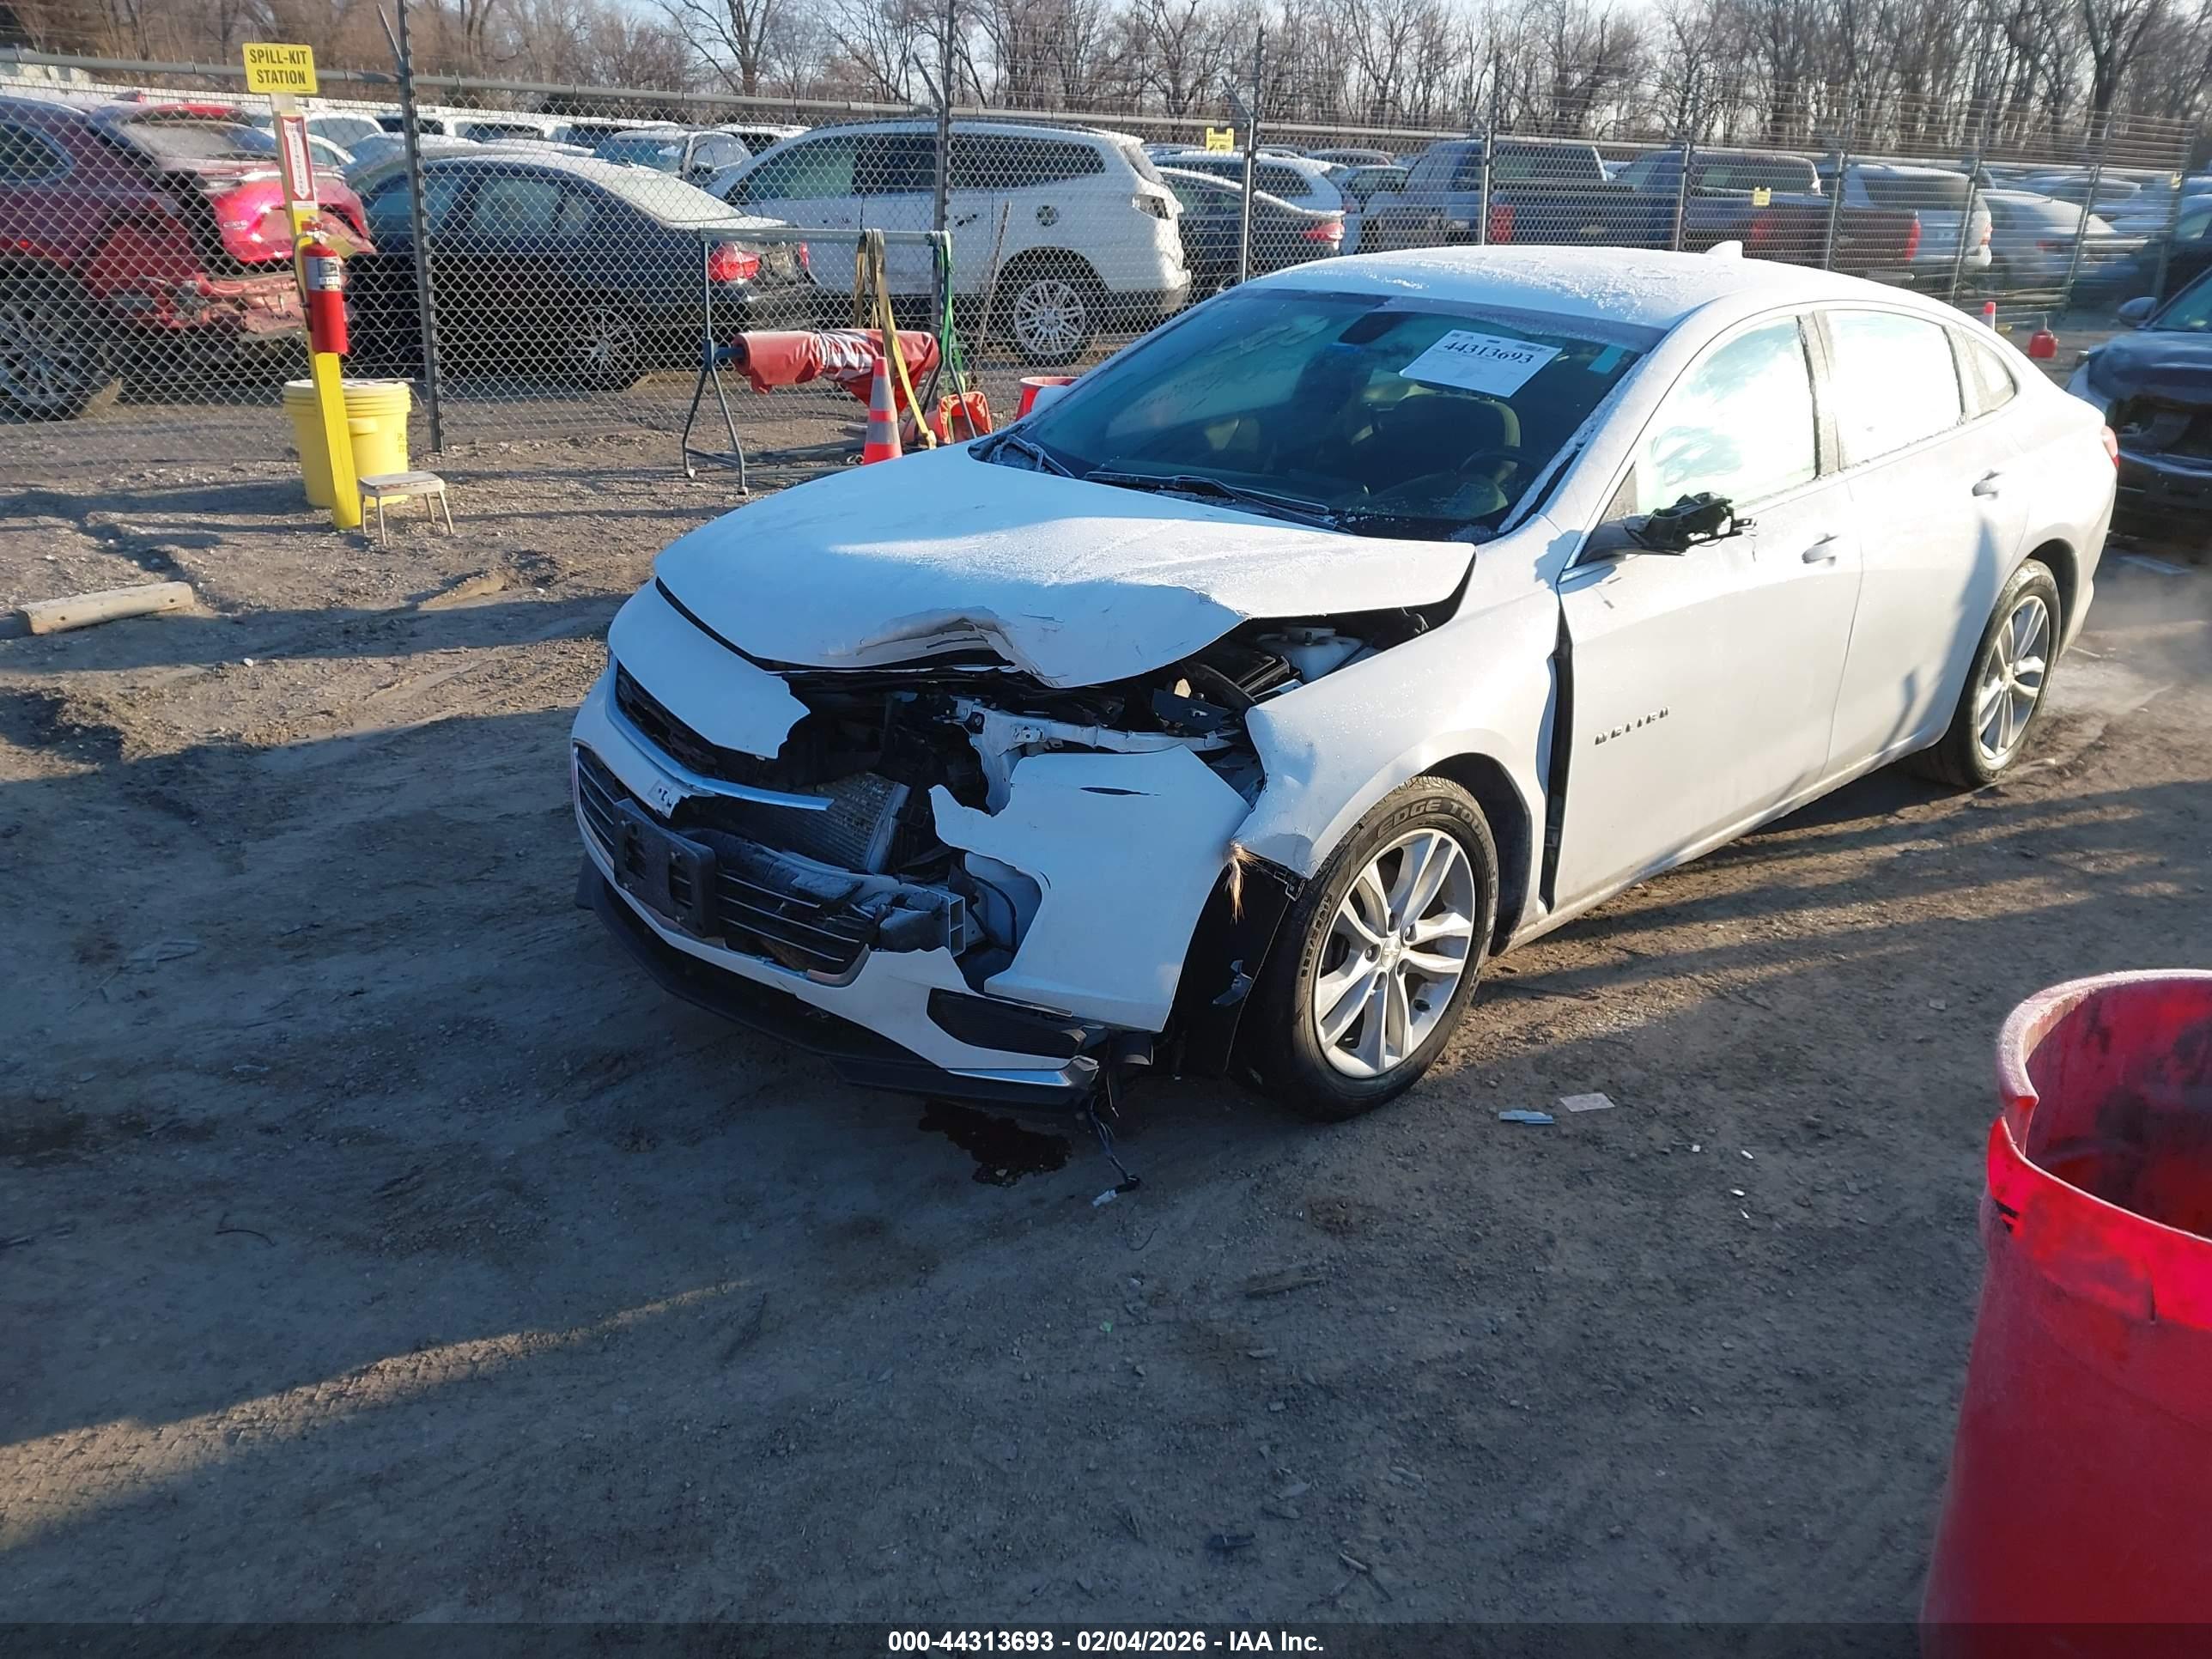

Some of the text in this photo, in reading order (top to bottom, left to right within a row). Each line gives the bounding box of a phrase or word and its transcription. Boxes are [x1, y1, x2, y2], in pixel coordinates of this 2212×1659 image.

[249, 49, 307, 64] SPILL-KIT
[257, 69, 307, 84] STATION
[1443, 341, 1534, 364] 44313693
[1376, 799, 1443, 839] EDGE
